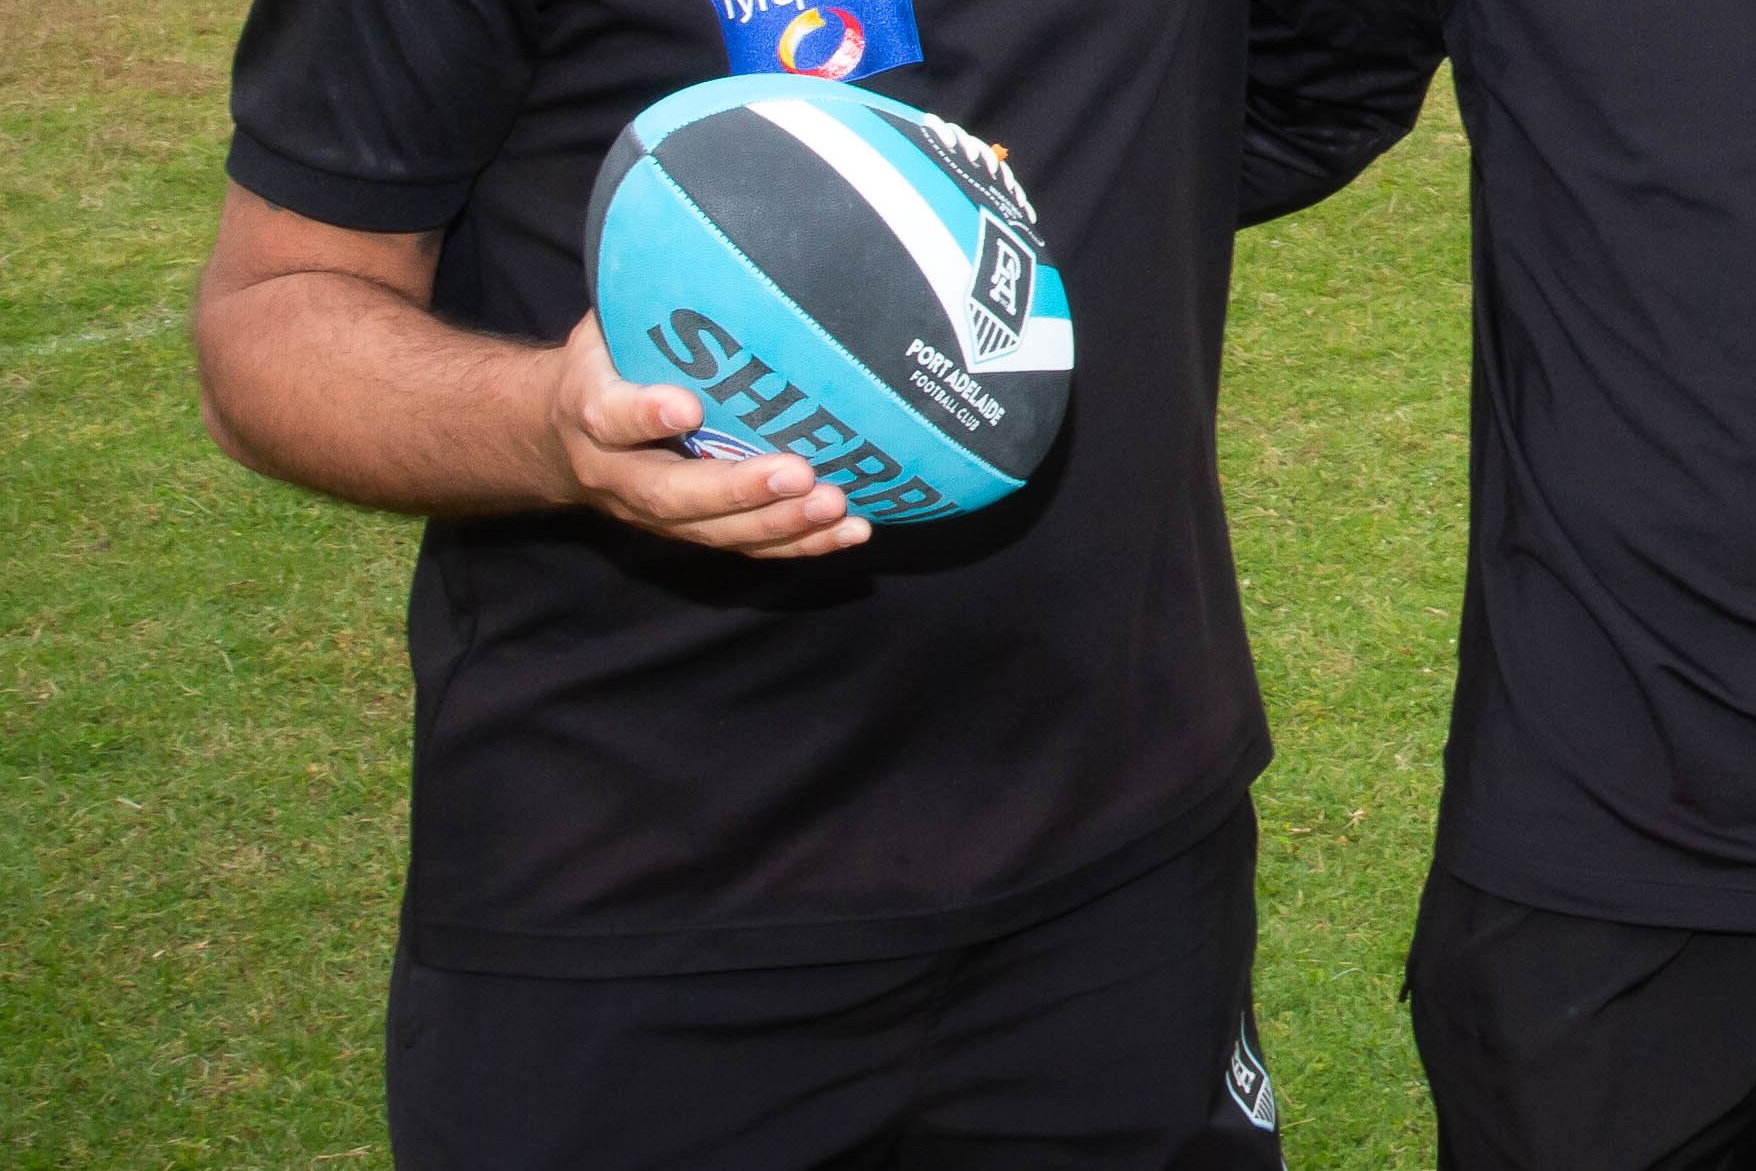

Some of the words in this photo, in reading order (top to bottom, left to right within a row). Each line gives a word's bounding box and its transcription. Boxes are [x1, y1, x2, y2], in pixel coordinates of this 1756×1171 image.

[905, 338, 954, 379] PORT
[943, 368, 1006, 427] ADELAIDE
[909, 370, 960, 414] FOOTBALL
[956, 408, 980, 432] CLUB
